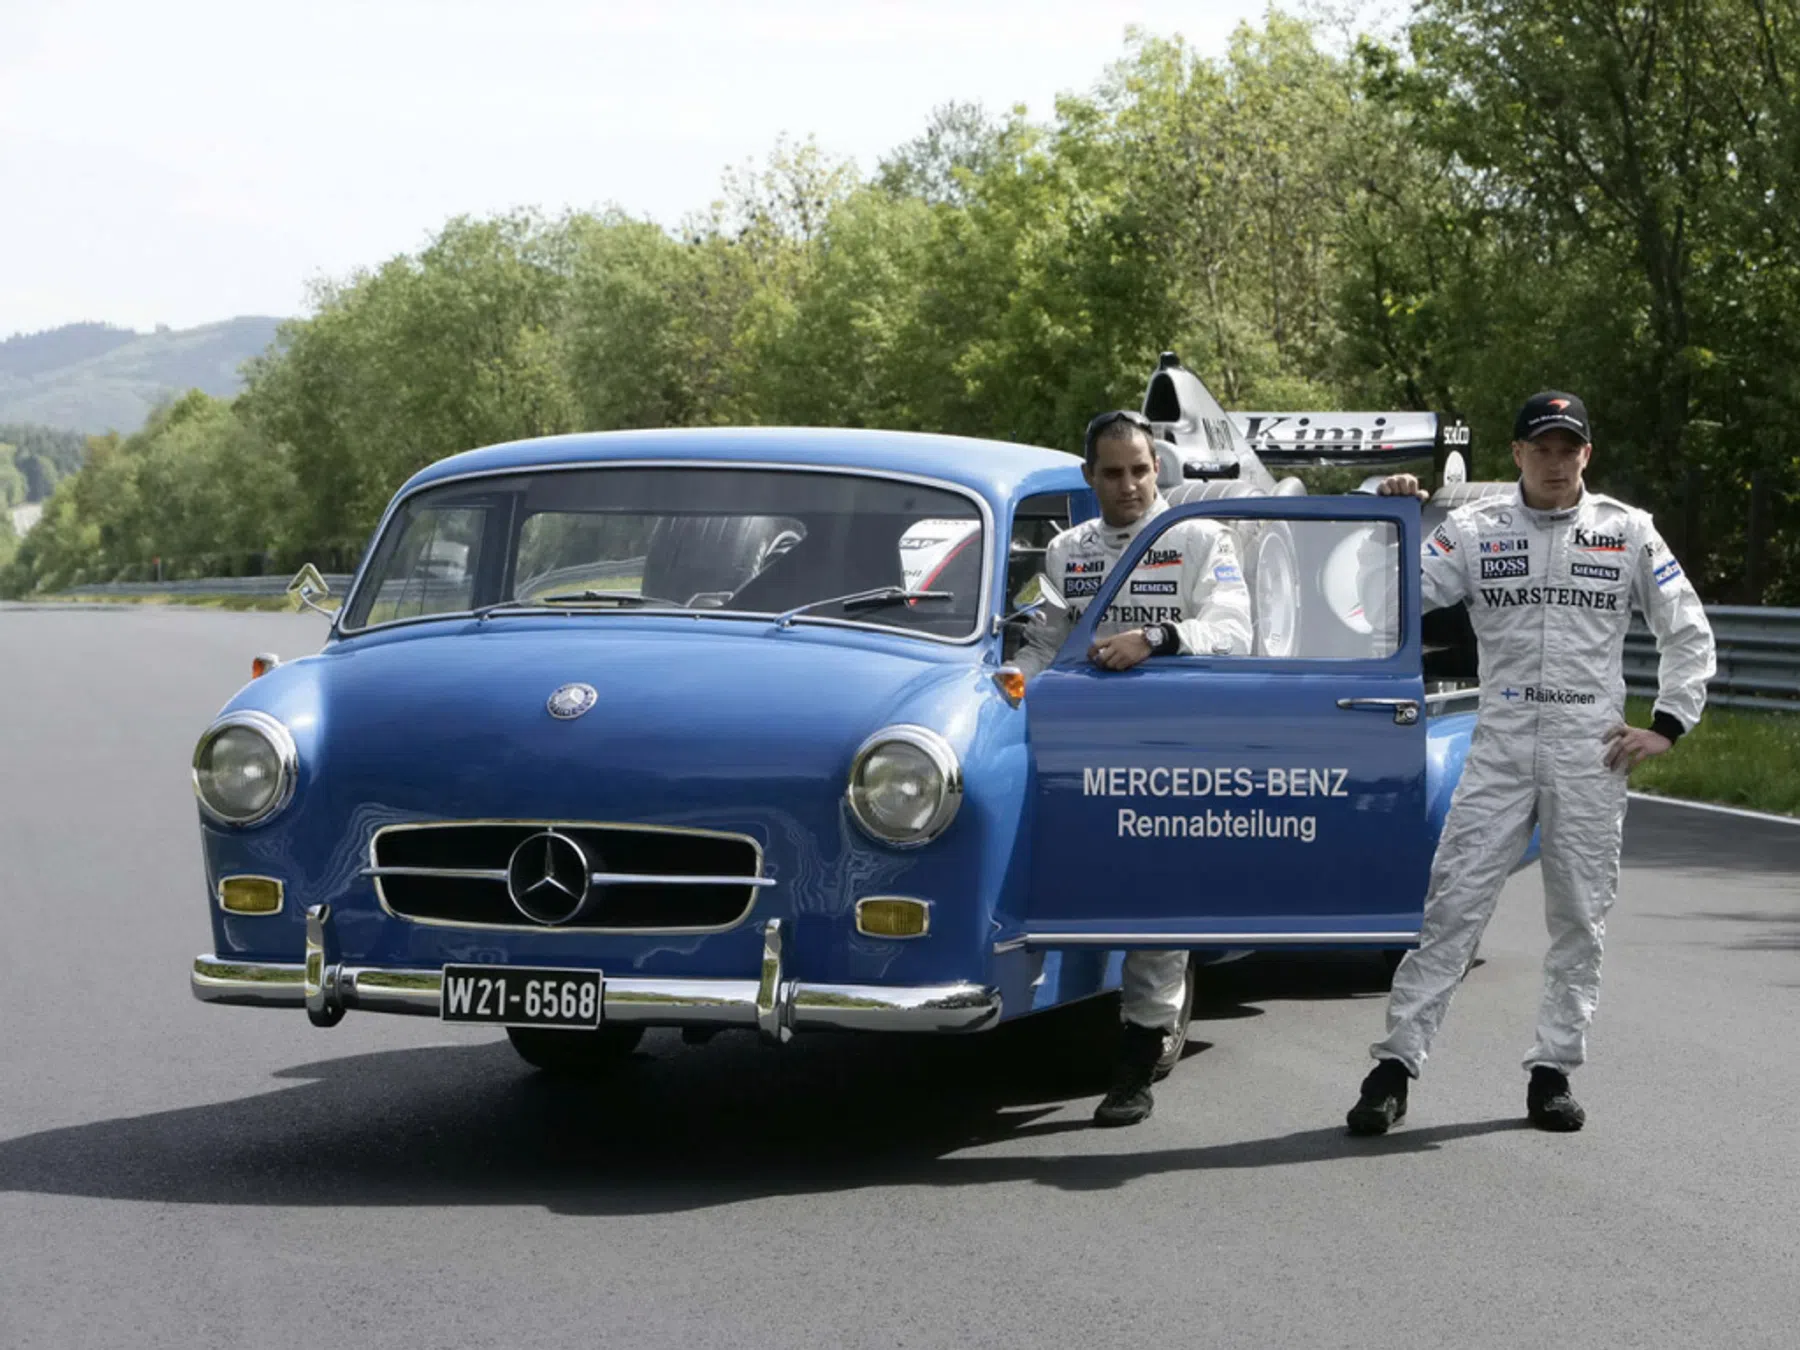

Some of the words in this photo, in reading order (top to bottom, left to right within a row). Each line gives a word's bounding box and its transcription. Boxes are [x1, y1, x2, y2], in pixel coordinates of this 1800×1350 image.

[1245, 416, 1389, 450] Kimi
[1480, 540, 1514, 553] Mobil
[1574, 529, 1626, 549] Kimi
[1484, 558, 1526, 573] BOSS
[1573, 565, 1618, 579] SIEMENS
[1066, 578, 1099, 592] BOSS
[1132, 583, 1175, 592] SIEMENS
[1480, 587, 1617, 611] WARSTEINER
[1083, 767, 1349, 797] MERCEDES-BENZ
[1117, 808, 1317, 842] Rennabteilung
[447, 977, 596, 1018] W21-6568
